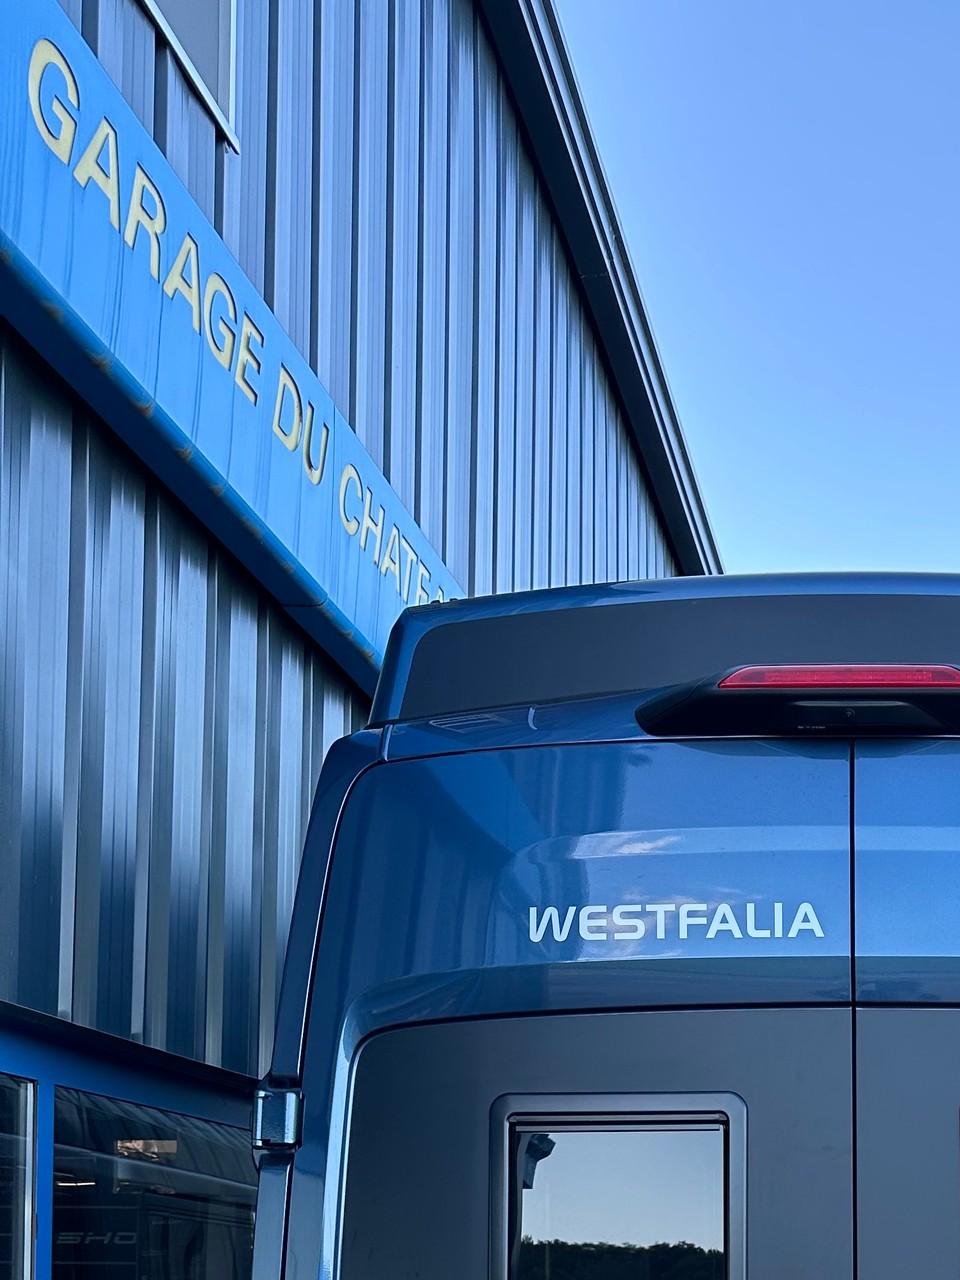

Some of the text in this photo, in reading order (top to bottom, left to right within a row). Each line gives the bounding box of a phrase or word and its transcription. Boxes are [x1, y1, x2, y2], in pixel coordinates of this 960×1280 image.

[27, 37, 264, 407] GARAGE
[272, 362, 330, 486] DU
[528, 901, 825, 943] WESTFALIA
